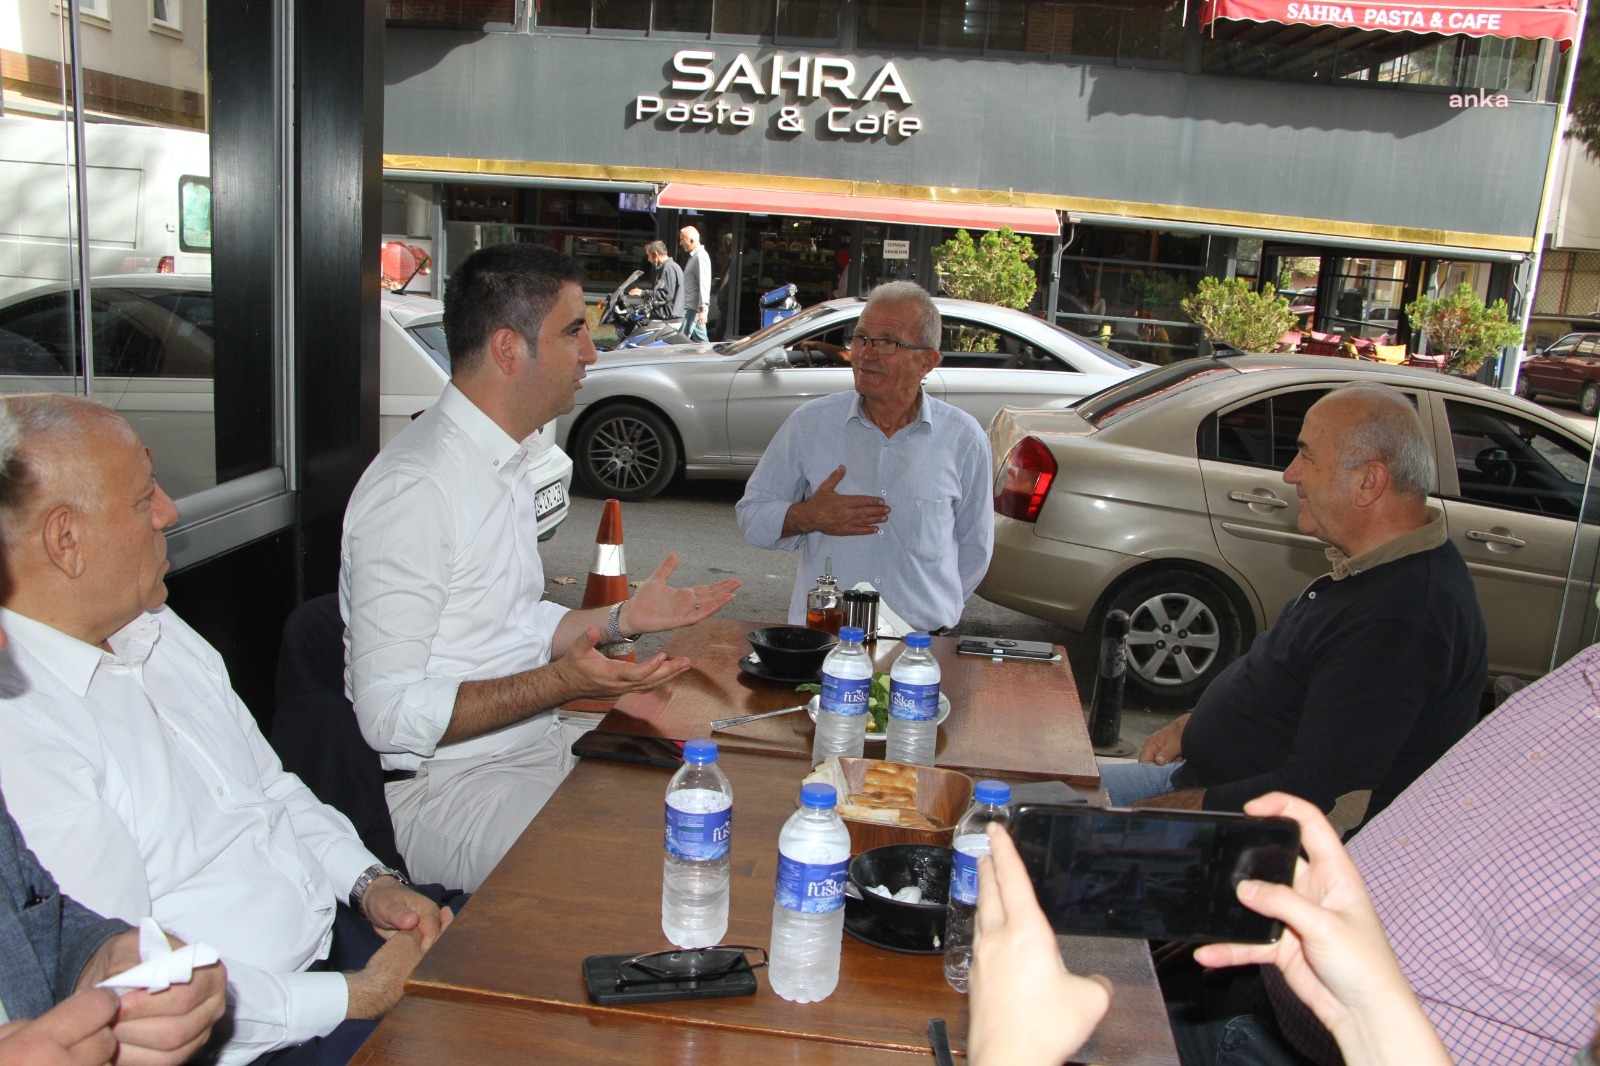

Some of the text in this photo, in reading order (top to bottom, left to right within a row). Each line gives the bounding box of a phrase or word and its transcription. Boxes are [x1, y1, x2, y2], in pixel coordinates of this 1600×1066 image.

[1287, 3, 1501, 30] SAHRA PASTA & CAFE
[672, 50, 912, 104] SAHRA
[636, 95, 922, 137] Pasta & Cafe
